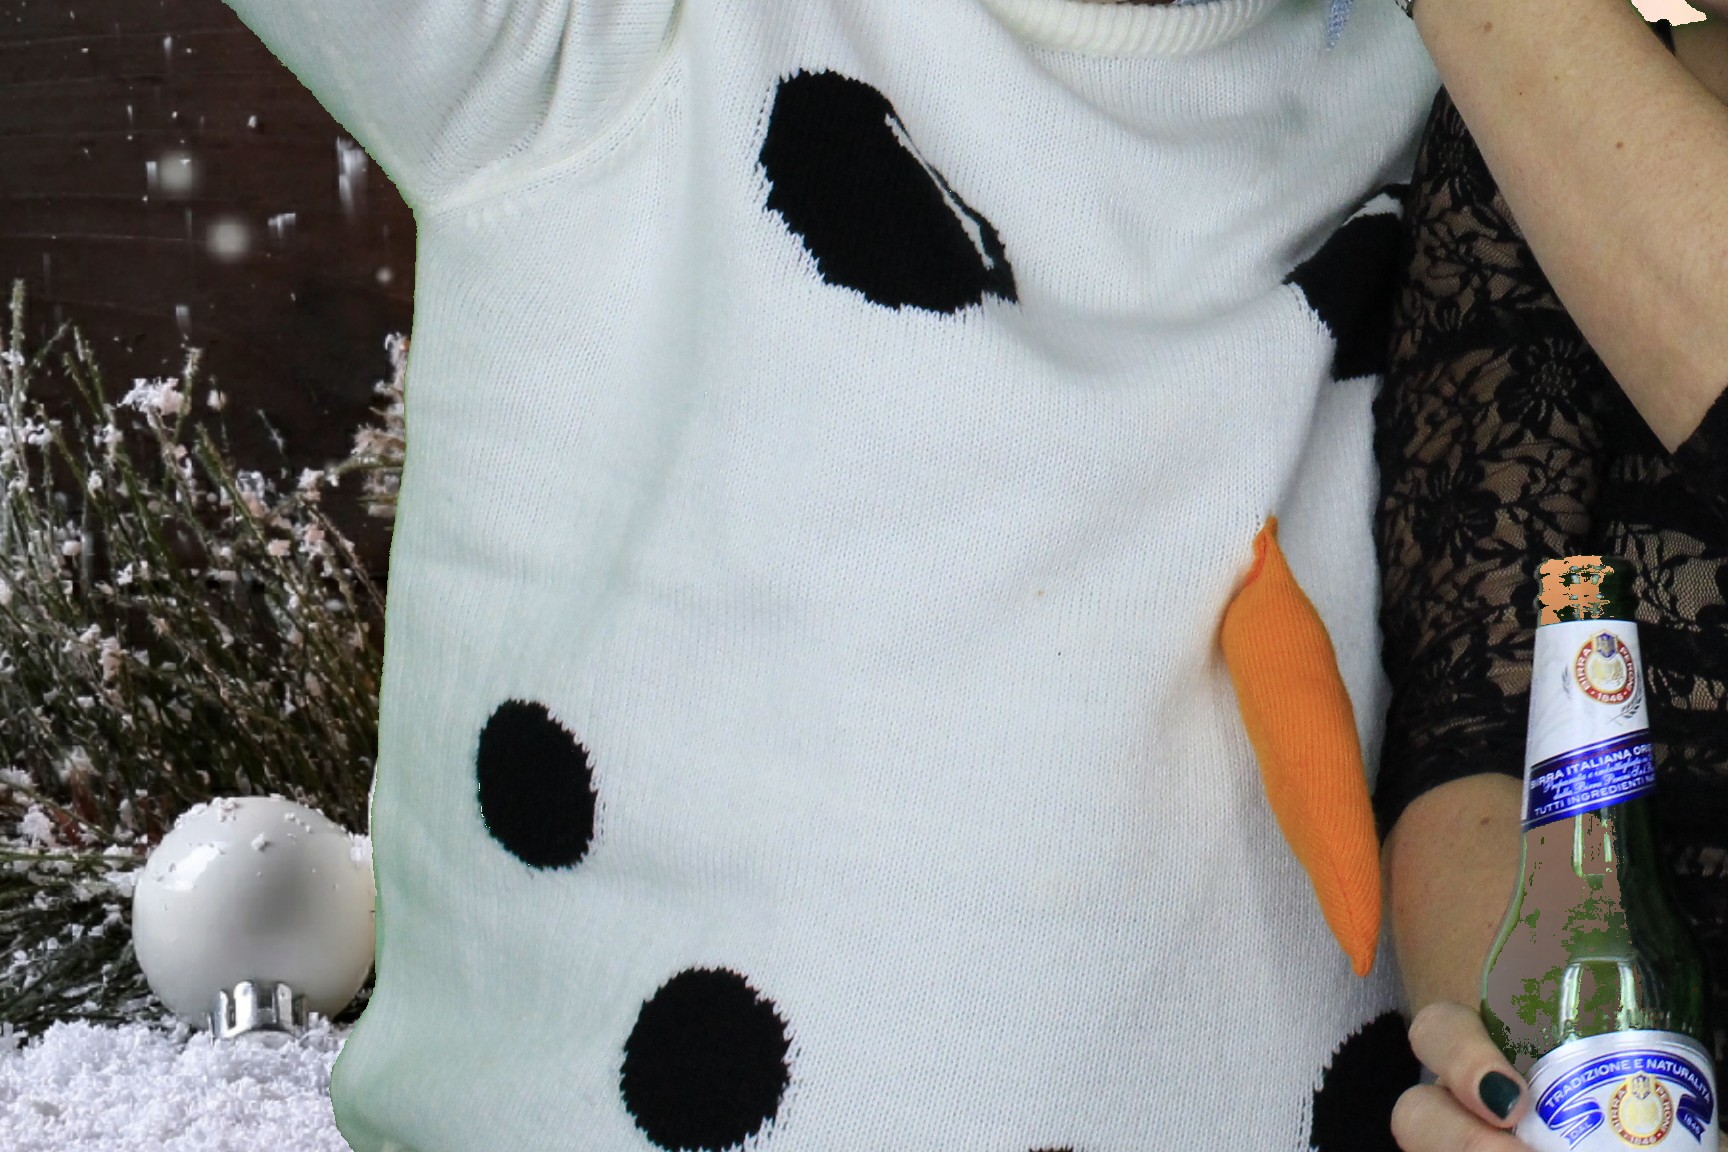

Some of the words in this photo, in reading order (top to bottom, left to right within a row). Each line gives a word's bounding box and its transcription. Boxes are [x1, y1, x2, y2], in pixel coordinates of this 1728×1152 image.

[1565, 748, 1633, 776] ITALIANA
[1534, 799, 1565, 816] TUTTI
[1567, 776, 1645, 806] INGREDIENTI
[1544, 1059, 1631, 1109] TRADIZIONE
[1634, 1058, 1644, 1069] E
[1569, 1121, 1594, 1140] DAL
